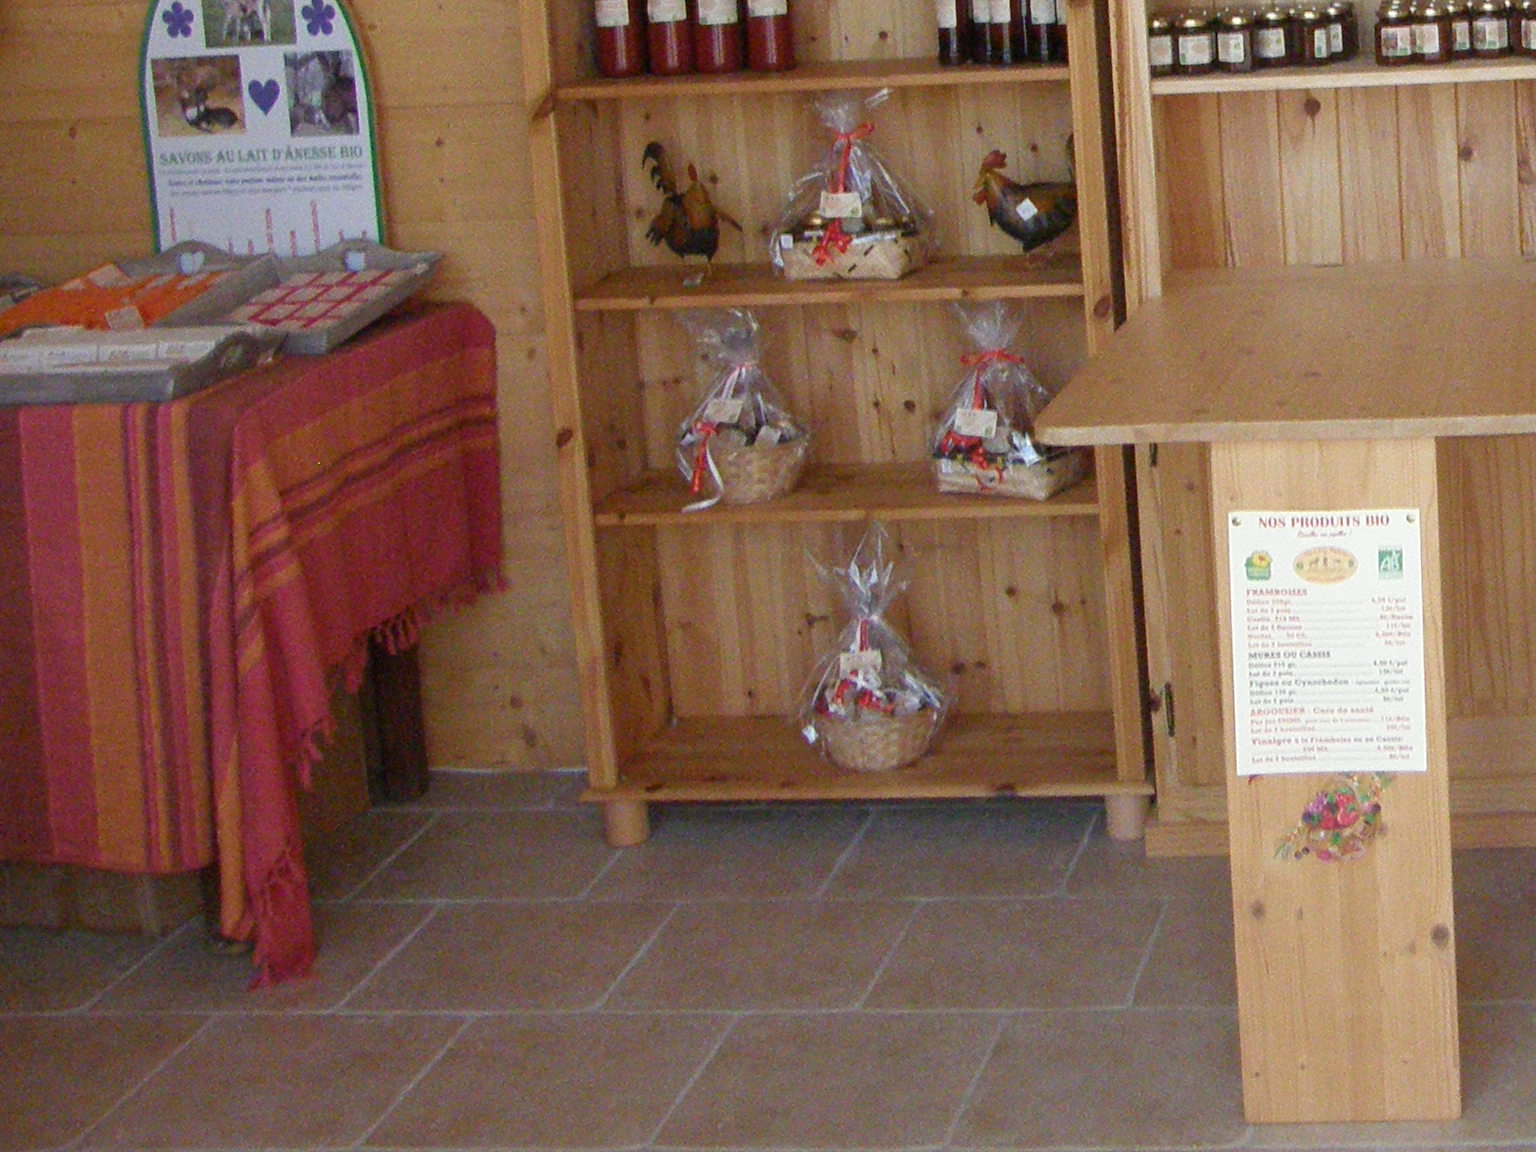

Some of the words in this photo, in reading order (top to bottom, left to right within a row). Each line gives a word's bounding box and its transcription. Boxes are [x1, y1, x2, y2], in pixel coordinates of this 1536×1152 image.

[160, 149, 213, 165] SAVONS
[216, 148, 235, 164] AU
[237, 147, 268, 162] LAIT
[339, 145, 364, 159] BIO
[1258, 516, 1287, 528] NOS
[1290, 515, 1361, 528] PRODUITS
[1365, 514, 1390, 527] BIO
